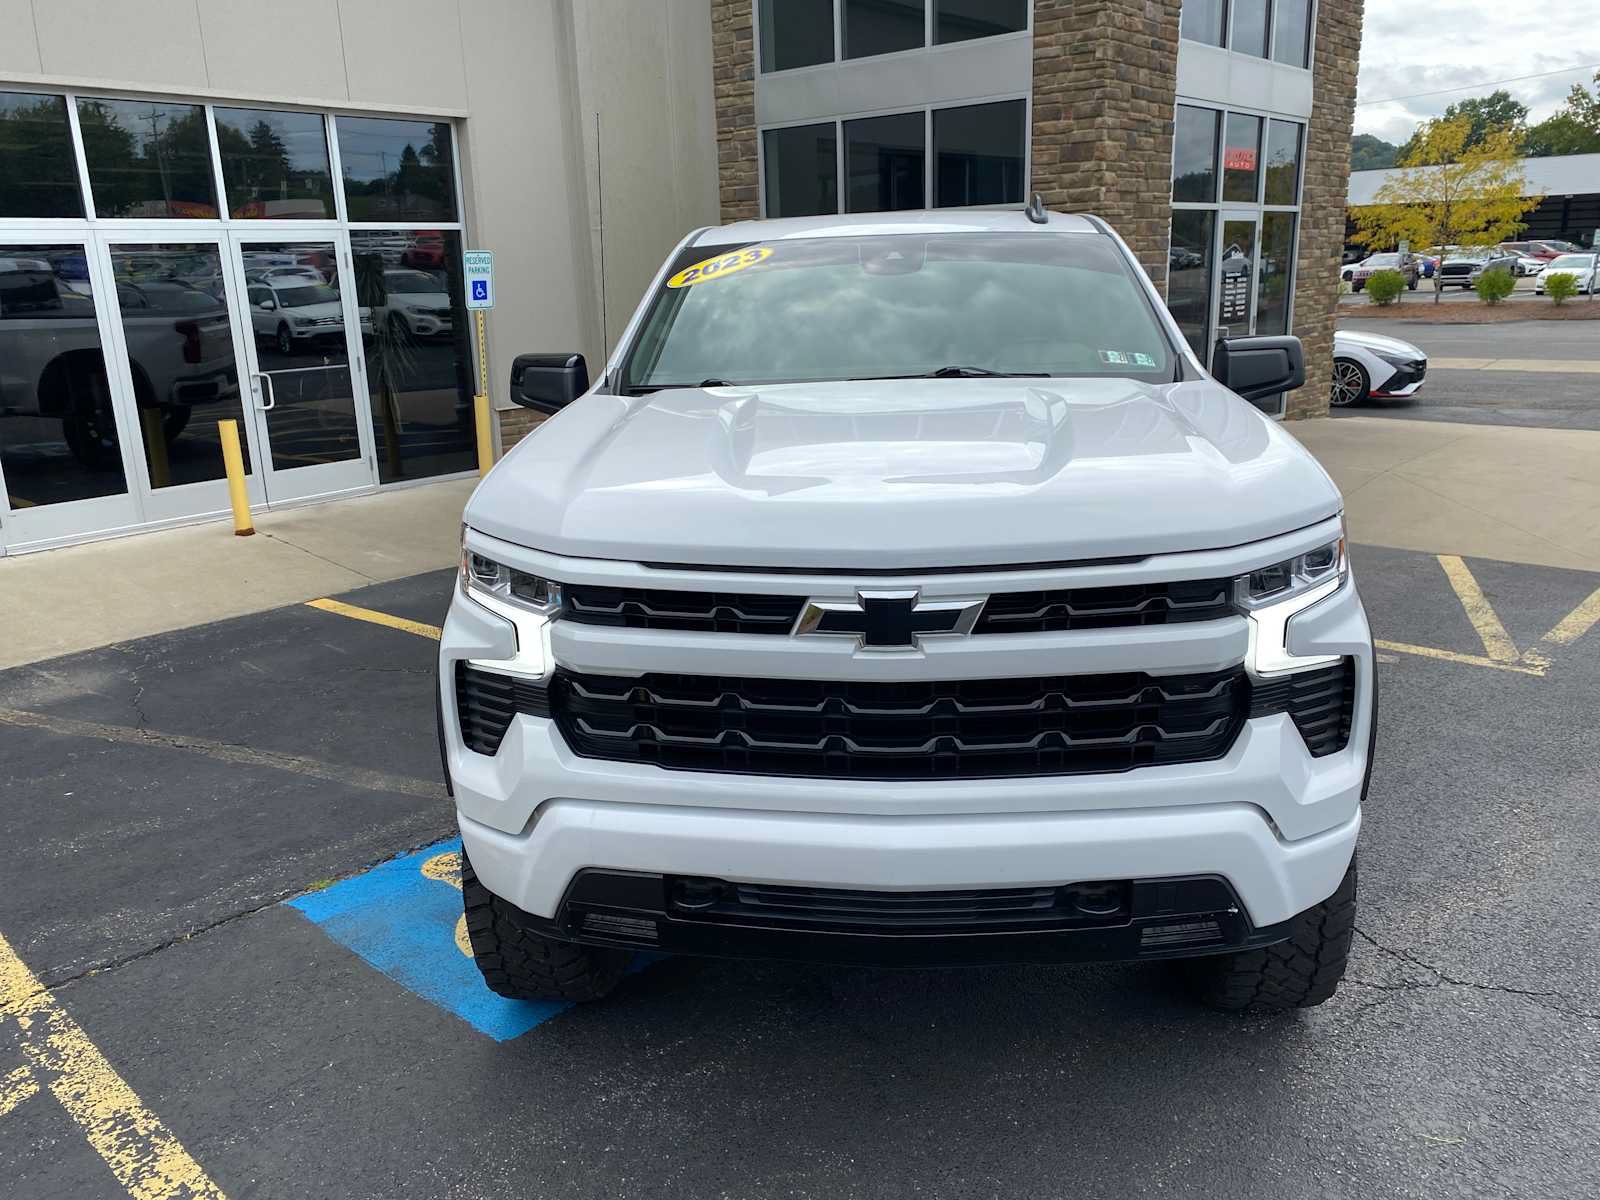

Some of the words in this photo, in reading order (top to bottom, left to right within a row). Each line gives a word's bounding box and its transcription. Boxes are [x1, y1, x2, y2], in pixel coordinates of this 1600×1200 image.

[1229, 161, 1250, 169] AUTO
[465, 256, 491, 264] RESERVED
[681, 250, 763, 284] 2023
